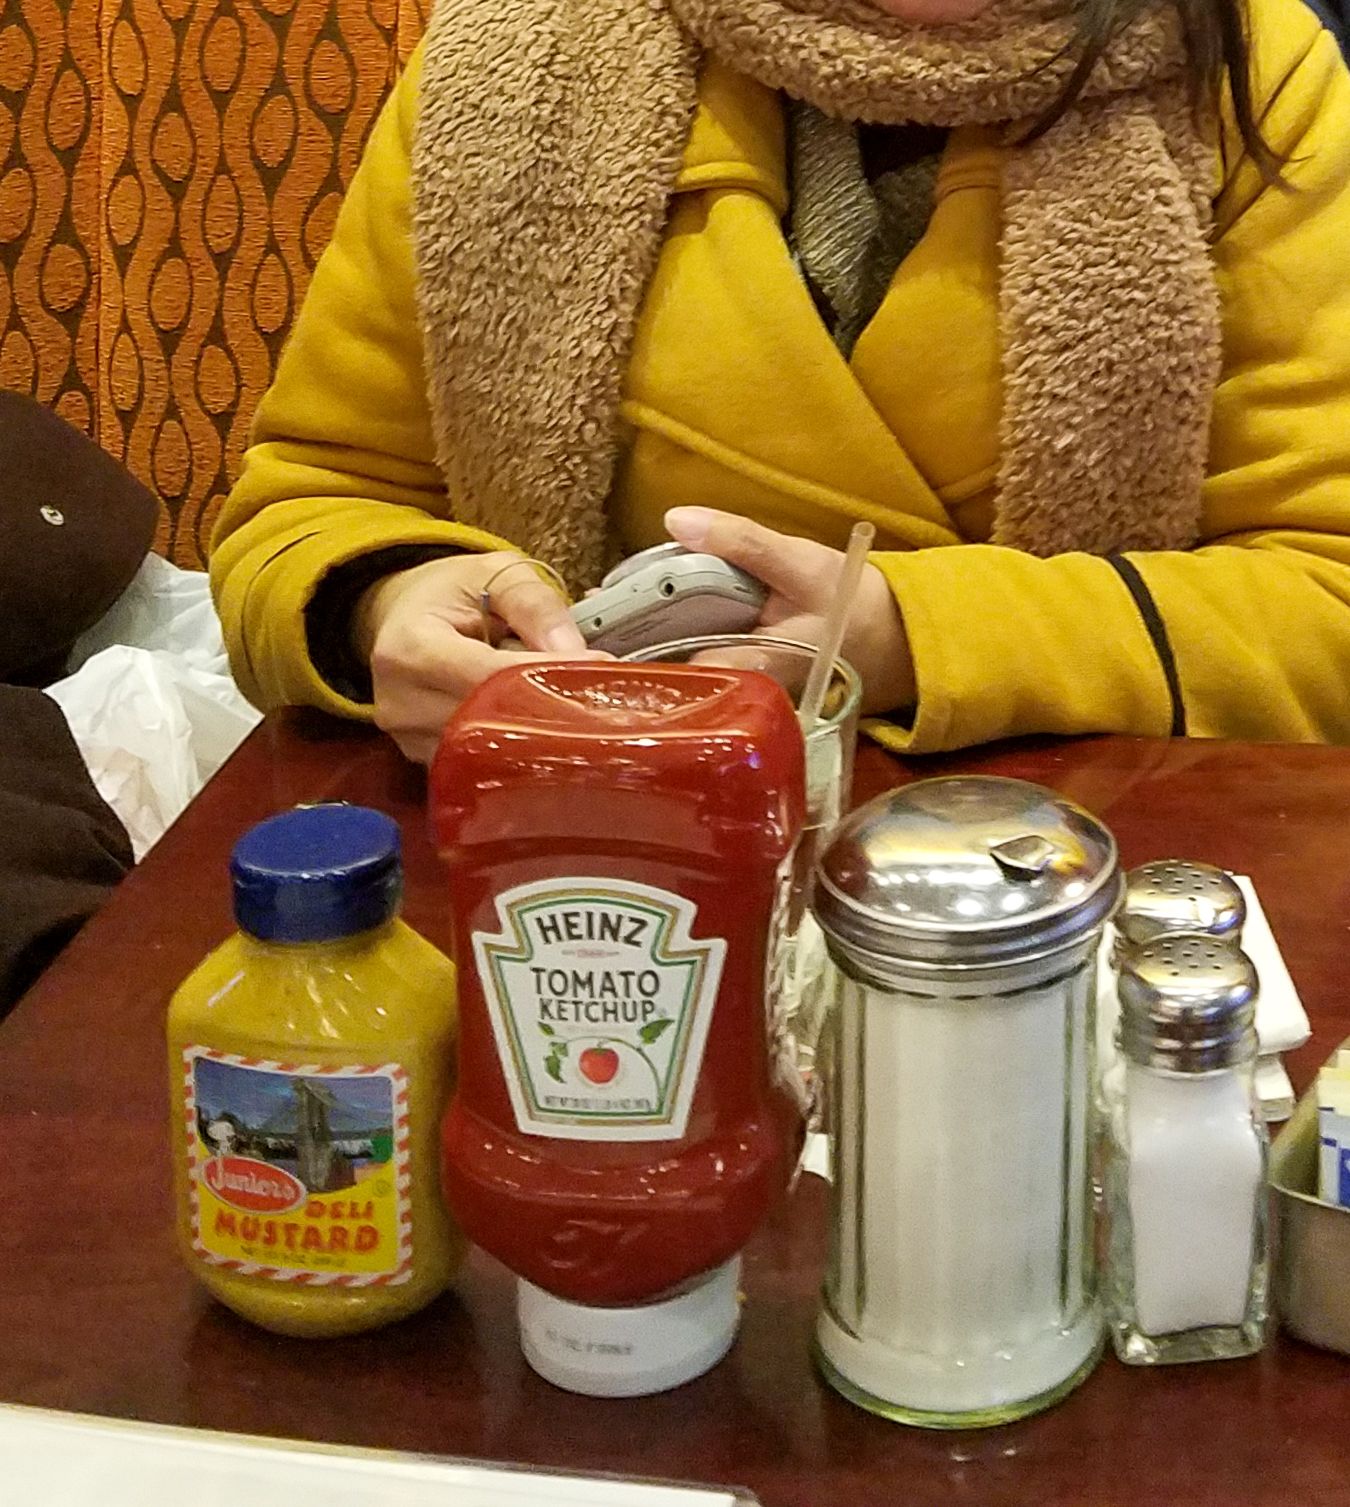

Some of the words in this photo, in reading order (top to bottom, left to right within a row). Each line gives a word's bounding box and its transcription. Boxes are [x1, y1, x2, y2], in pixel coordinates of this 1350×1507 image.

[535, 910, 649, 948] HEINZ
[529, 966, 660, 999] TOMATO
[539, 998, 656, 1023] KETCHUP
[304, 1199, 374, 1220] DELI
[214, 1206, 380, 1253] MUSTARD
